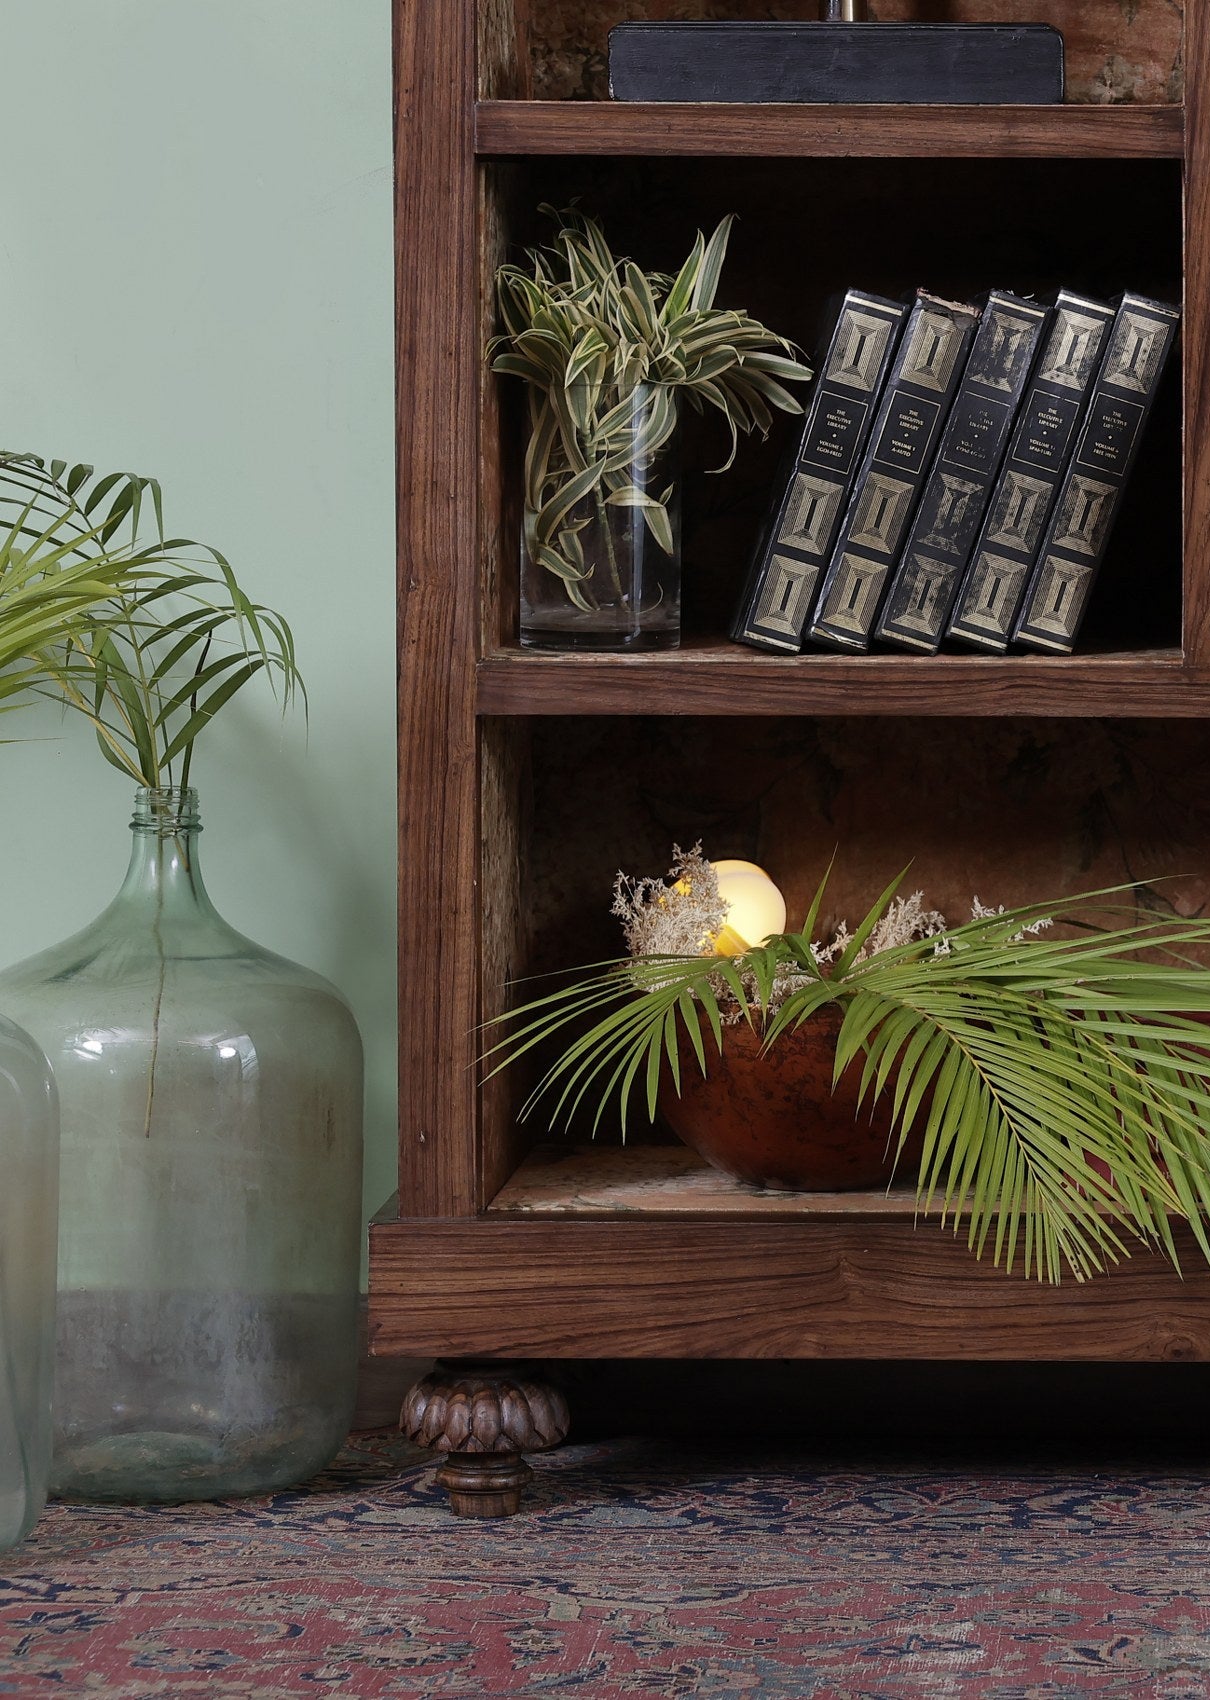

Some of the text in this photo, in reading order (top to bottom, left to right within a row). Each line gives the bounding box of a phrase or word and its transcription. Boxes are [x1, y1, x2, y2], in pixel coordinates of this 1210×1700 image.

[1048, 407, 1058, 415] THE
[826, 413, 852, 424] EXECUTIVE
[899, 414, 924, 426] EXECUTIVE
[1038, 412, 1063, 424] EXECUTIVE
[827, 421, 847, 430] LIBRARY
[899, 420, 920, 430] LIBRARY
[1038, 420, 1059, 429] LIBRARY
[819, 440, 840, 450] VOLUME
[892, 440, 912, 450] VOLUME
